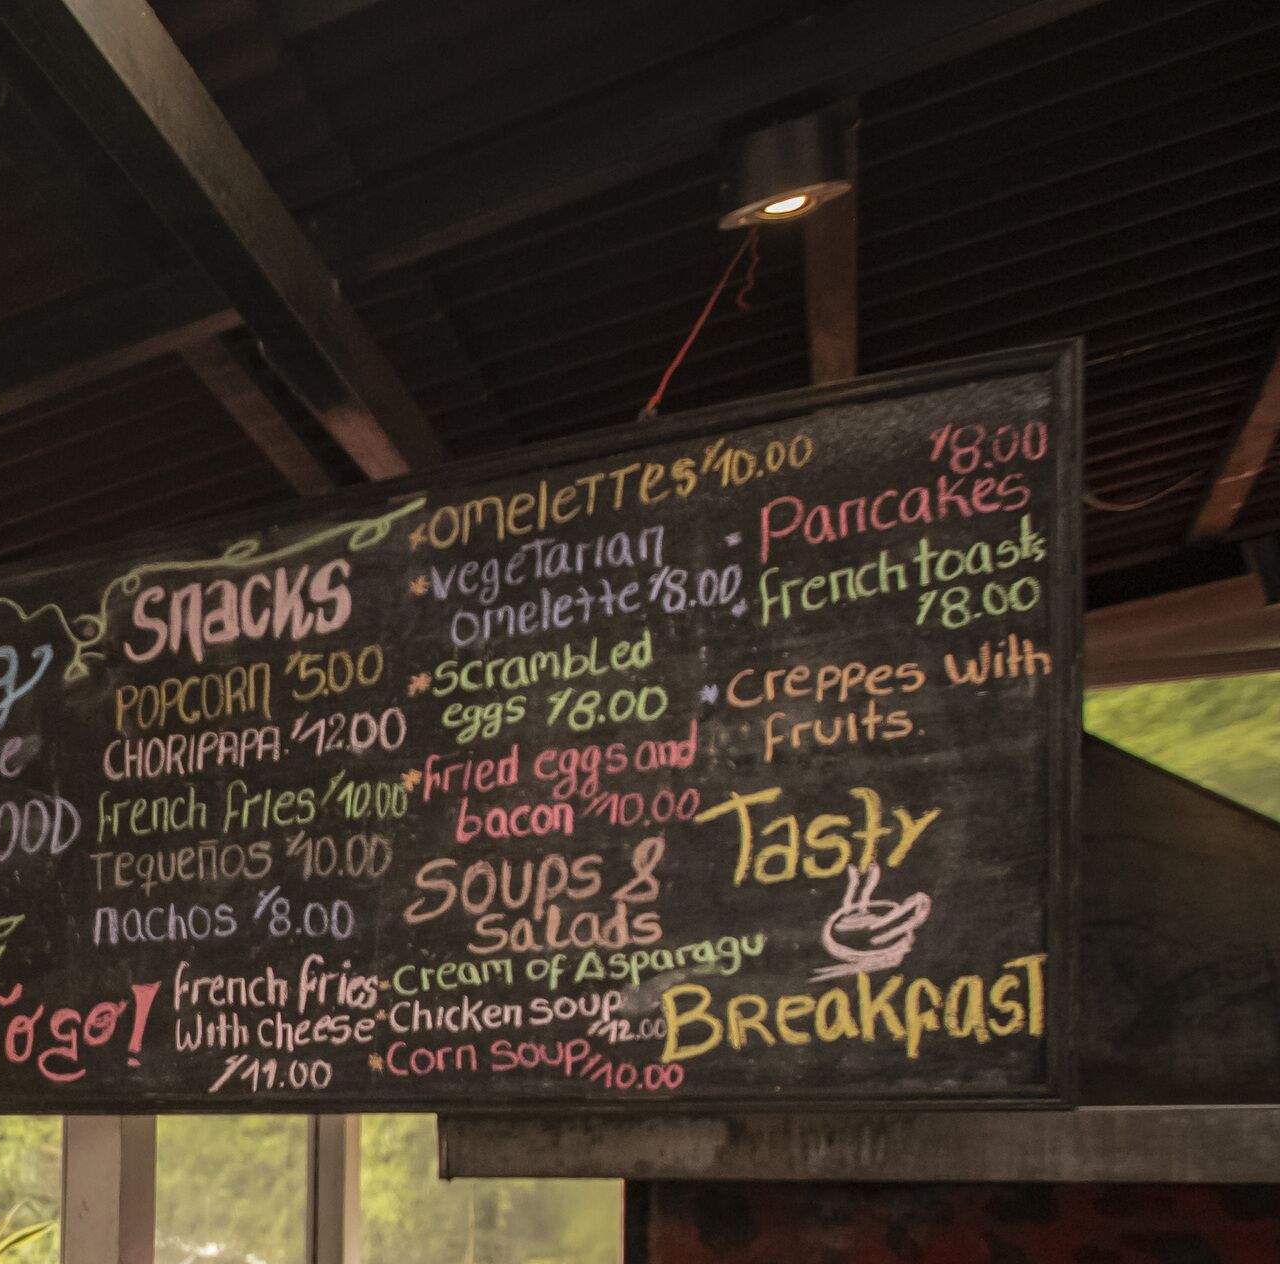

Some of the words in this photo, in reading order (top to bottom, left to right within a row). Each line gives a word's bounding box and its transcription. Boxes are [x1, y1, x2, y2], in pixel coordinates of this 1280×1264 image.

[442, 696, 528, 744] eggs
[423, 743, 521, 802] fried
[533, 743, 628, 800] eggs
[633, 718, 698, 774] and
[223, 779, 316, 834] fries
[455, 797, 574, 844] bacon
[694, 787, 942, 887] Tasty
[612, 833, 667, 902] &
[93, 903, 238, 945] nachos
[297, 952, 380, 1016] fries
[525, 952, 569, 992] of
